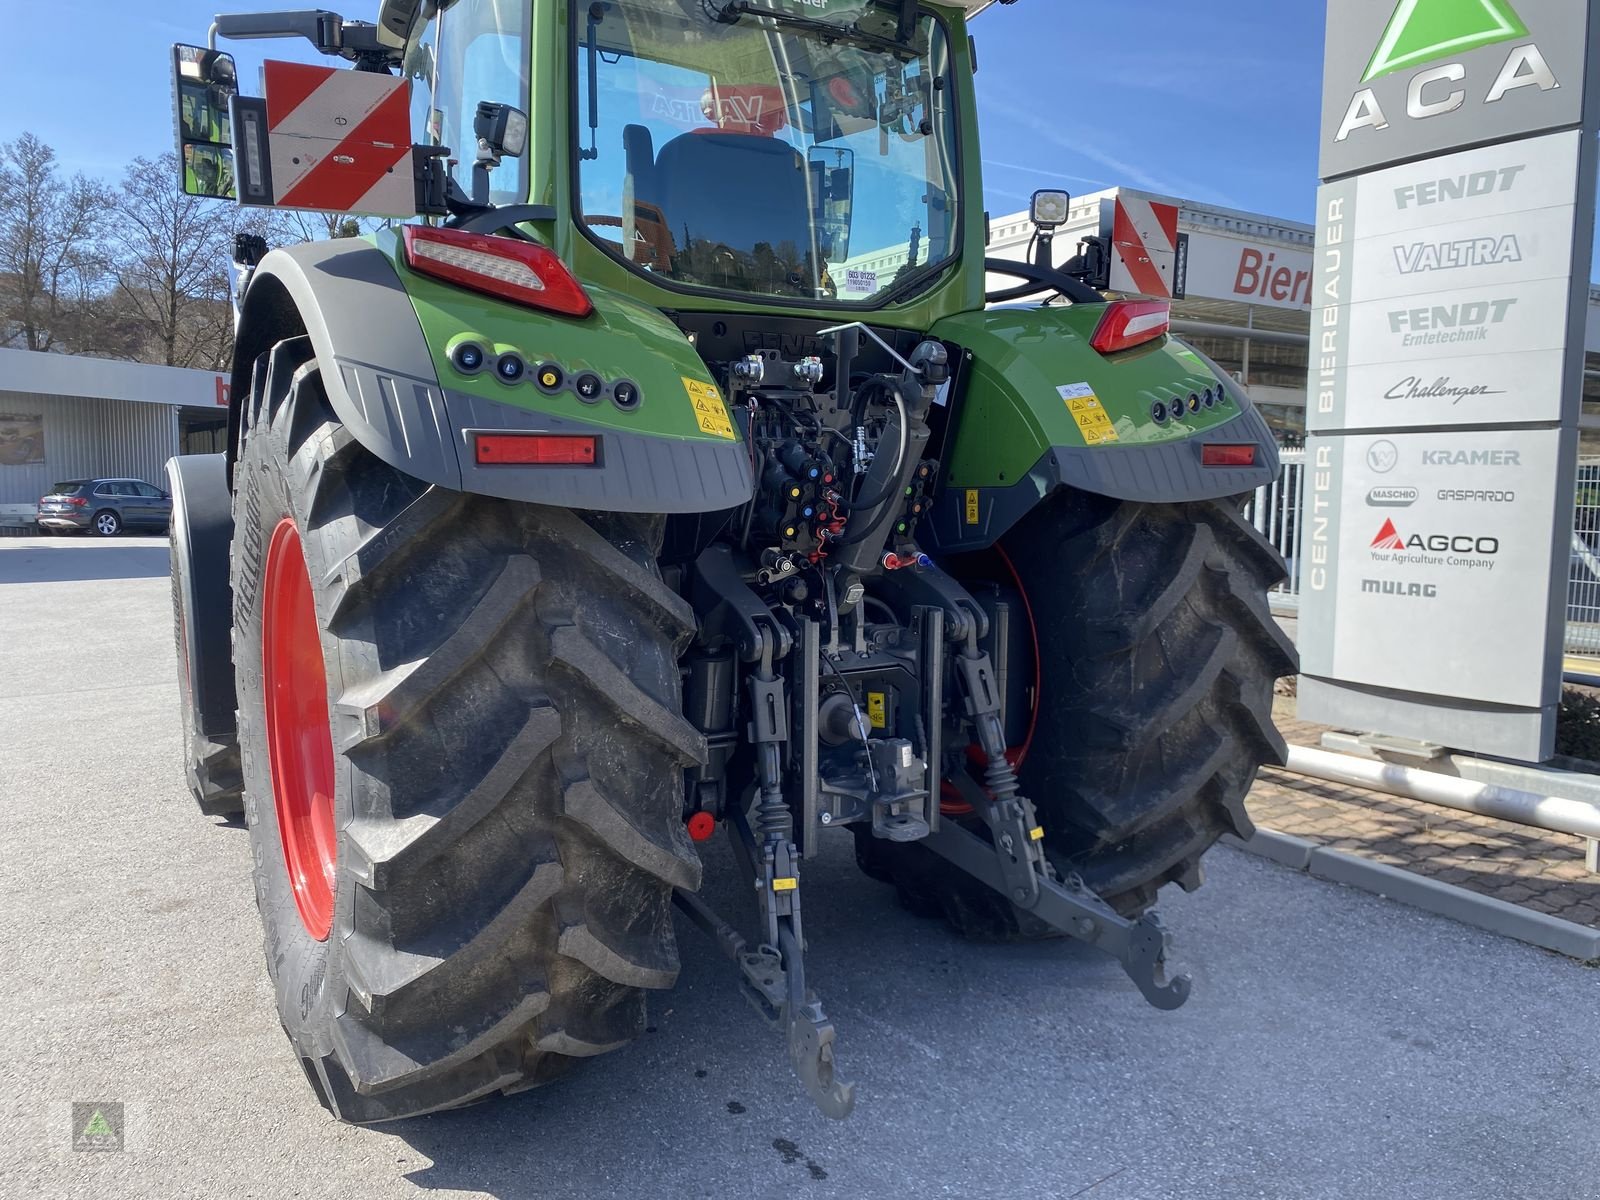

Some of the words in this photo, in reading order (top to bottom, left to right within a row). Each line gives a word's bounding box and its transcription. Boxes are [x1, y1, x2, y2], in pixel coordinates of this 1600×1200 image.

[1334, 42, 1561, 143] ACA
[1393, 164, 1526, 210] FENDT
[1393, 234, 1521, 274] VALTRA
[1318, 197, 1344, 413] BIERBAUER
[1387, 298, 1518, 333] FENDT
[1401, 326, 1488, 347] Erntetechnik
[1384, 376, 1507, 405] Challenger
[1422, 450, 1521, 466] KRAMER
[1372, 490, 1417, 500] MASCHIO
[1437, 489, 1515, 502] GASPARDO
[1311, 445, 1332, 591] CENTER
[1405, 534, 1499, 554] AGCO
[1370, 551, 1390, 562] Your
[1391, 553, 1444, 566] Agriculture
[1446, 556, 1495, 570] Company
